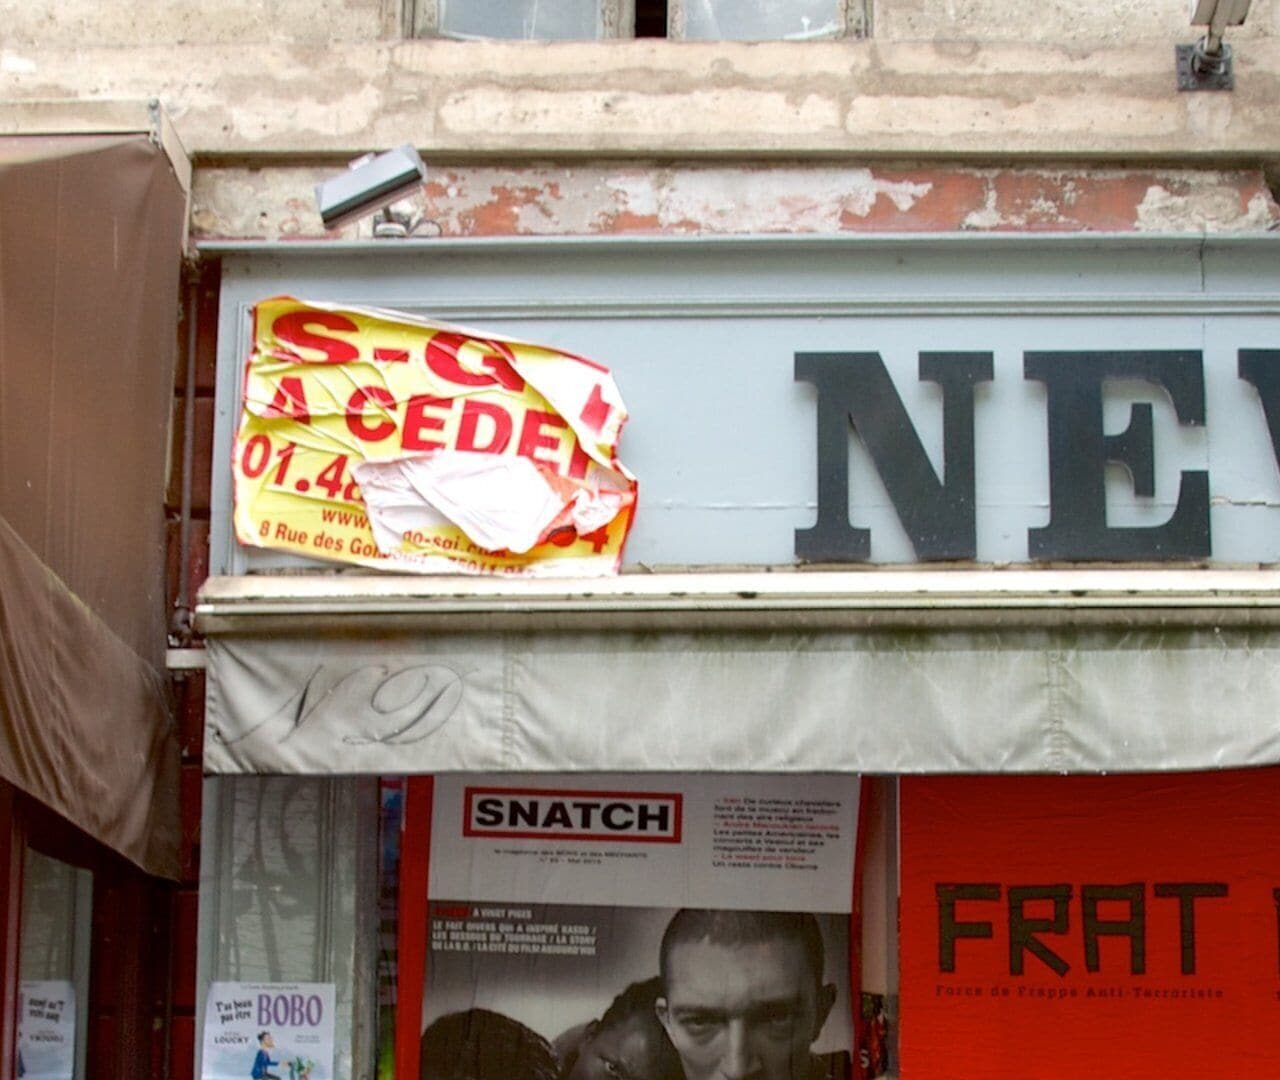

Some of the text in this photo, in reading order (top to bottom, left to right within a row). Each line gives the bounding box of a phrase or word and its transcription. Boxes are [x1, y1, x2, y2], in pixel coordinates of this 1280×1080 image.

[263, 377, 310, 425] A
[275, 523, 307, 543] Rue
[313, 531, 342, 550] des
[476, 799, 669, 833] SNATCH
[935, 882, 1229, 977] FRAT
[258, 994, 322, 1026] BOBO
